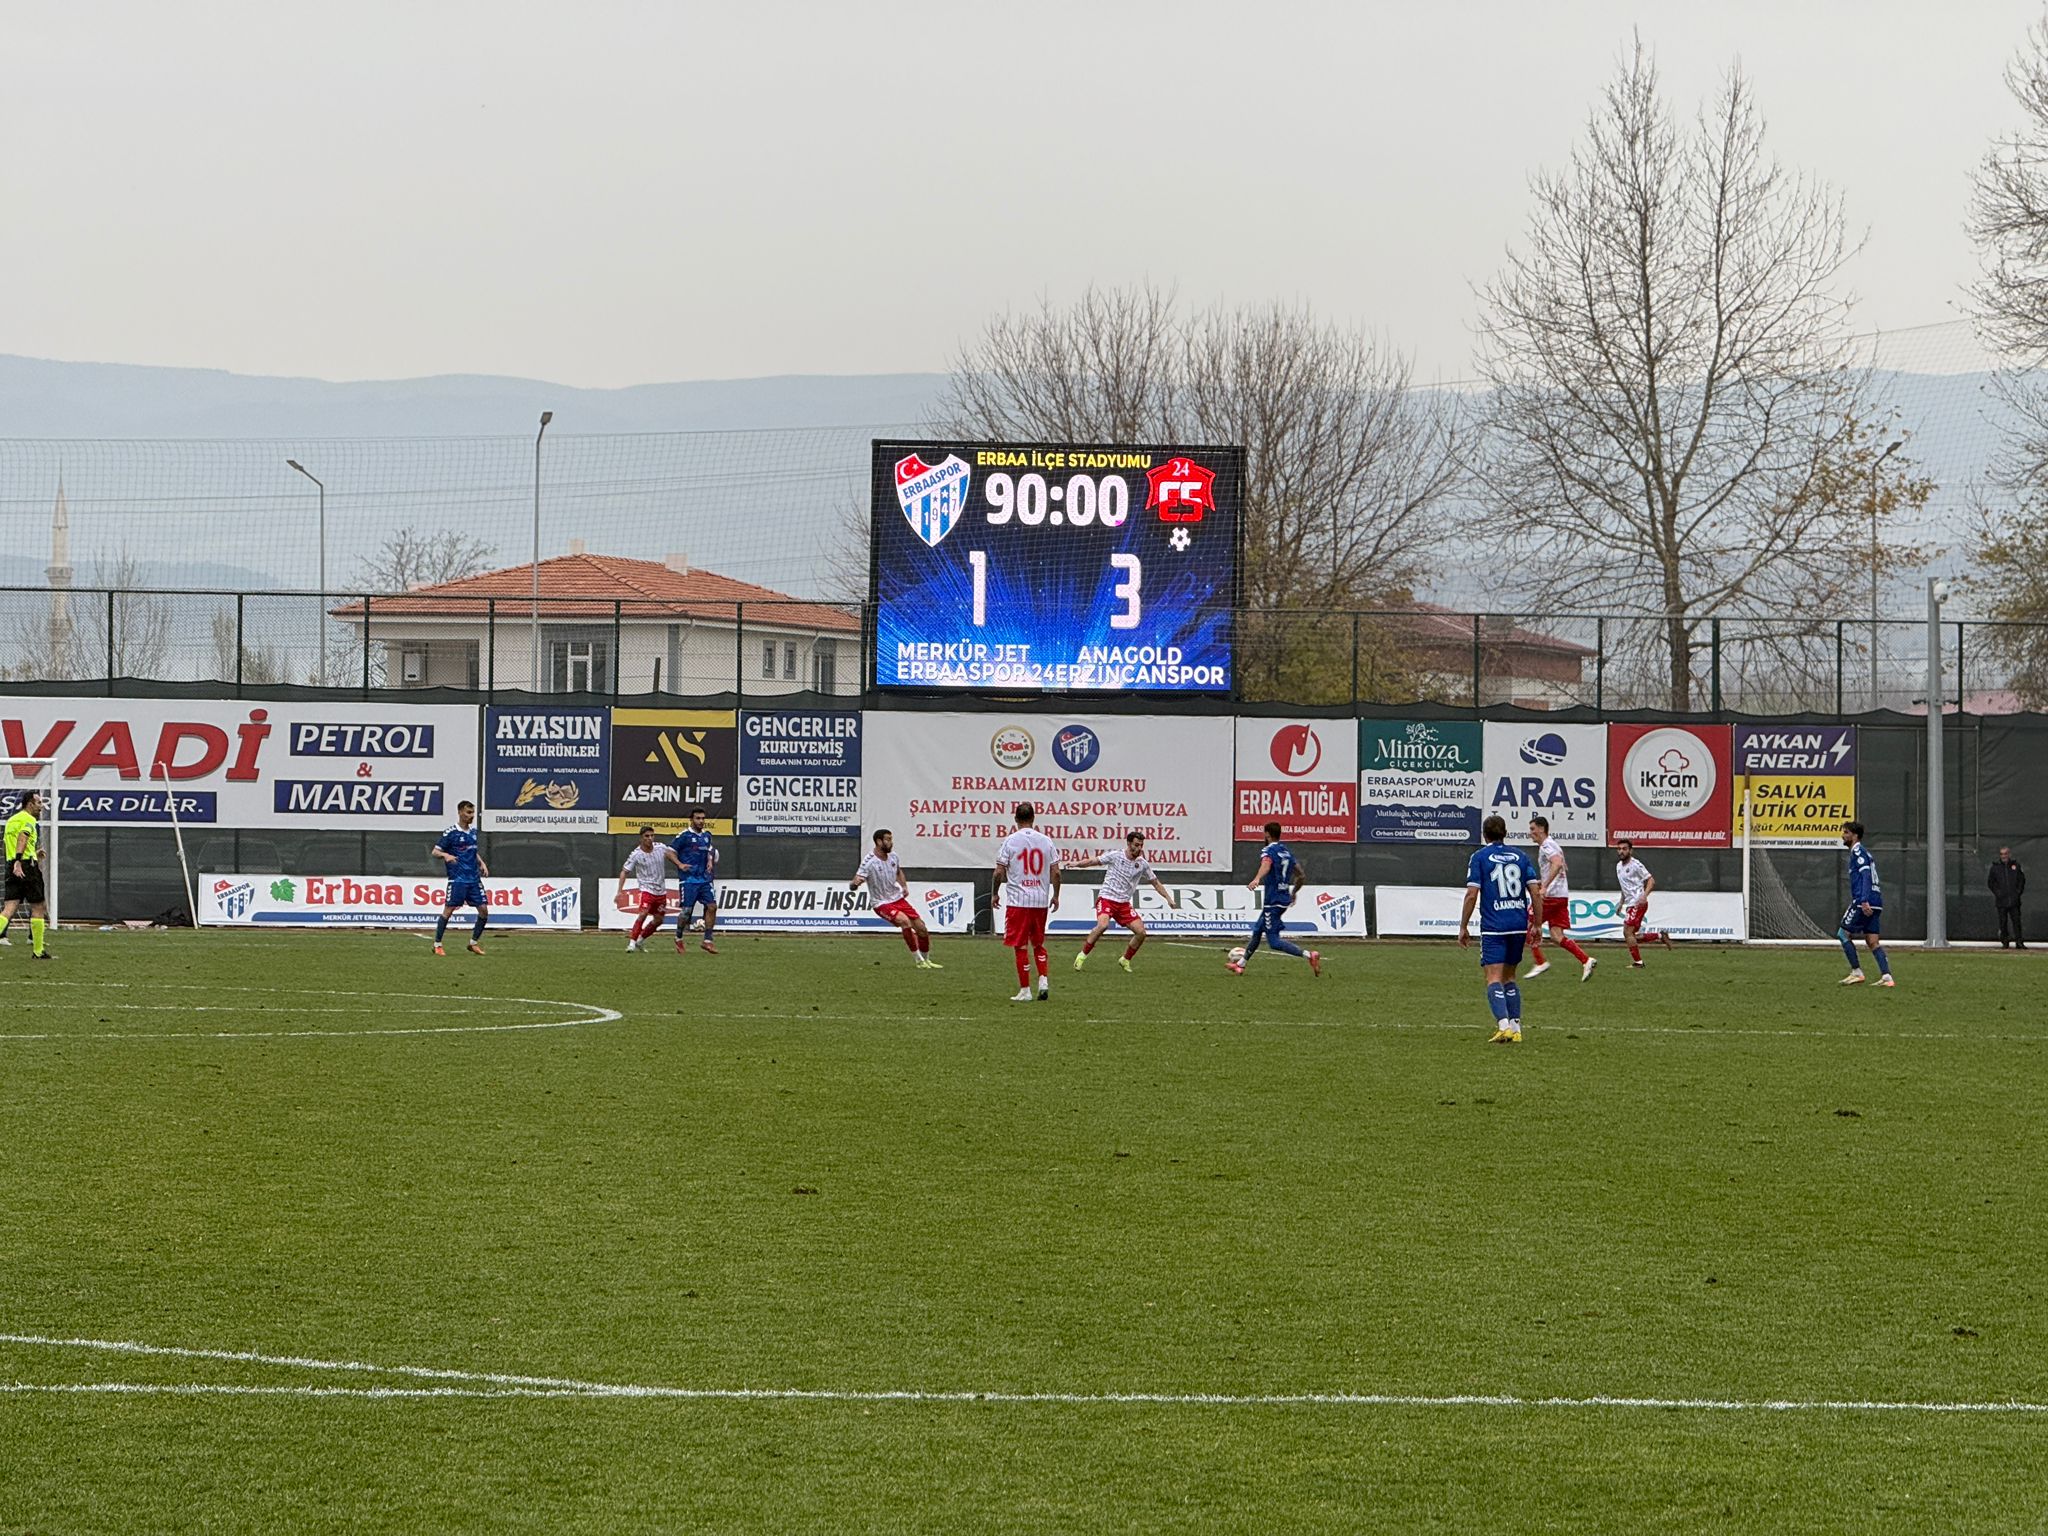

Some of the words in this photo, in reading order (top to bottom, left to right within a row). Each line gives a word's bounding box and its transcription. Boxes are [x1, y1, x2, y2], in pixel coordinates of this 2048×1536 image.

[977, 452, 1027, 466] ERBAA
[1032, 450, 1065, 470] İLÇE
[1071, 454, 1151, 469] STADYUMU
[1173, 460, 1190, 477] 24
[902, 462, 961, 500] ERBAASPOR
[985, 472, 1129, 527] 90:00
[969, 551, 987, 627] 1
[1110, 553, 1142, 630] 3
[898, 638, 987, 661] MERKÜR
[993, 644, 1031, 662] JET
[1077, 645, 1183, 665] ANAGOLD
[898, 661, 1027, 681] ERBAASPOR
[1031, 661, 1225, 685] 24ERZİNCANSPOR
[495, 715, 602, 740] AYASUN
[745, 716, 858, 738] GENCERLER
[1, 708, 272, 782] VADİ
[296, 724, 428, 754] PETROL
[760, 738, 844, 758] KURUYEMİŞ
[1742, 733, 1822, 749] AYKAN
[497, 744, 537, 757] TARIM
[539, 742, 600, 758] ÜRÜNLERİ
[1374, 738, 1469, 765] Mimoza
[1745, 750, 1827, 769] ENERJİ
[356, 762, 372, 778] &
[1389, 761, 1455, 769] ÇİÇEKÇİLİK
[746, 776, 858, 798] GENCERLER
[952, 776, 1066, 792] ERBAAMIZIN
[1072, 778, 1146, 793] GURURU
[1367, 776, 1476, 787] ERBAASPOR'UMUZA
[1641, 771, 1698, 788] ikram
[288, 783, 440, 813] MARKET
[622, 784, 681, 803] ASRIN
[685, 781, 723, 804] LİFE
[1369, 788, 1430, 799] BAŞARILAR
[1432, 788, 1474, 799] DİLERİZ
[1491, 776, 1596, 808] ARAS
[1651, 789, 1688, 799] yemek
[1756, 781, 1827, 799] SALVİA
[120, 794, 204, 814] DİLER.
[750, 799, 788, 812] DÜĞÜN
[791, 802, 857, 813] SALONLARI
[909, 796, 1005, 817] ŞAMPİYON
[1010, 801, 1188, 817] EBAASPOR'UMUZA
[1240, 789, 1294, 816] ERBAA
[1299, 784, 1350, 817] TUĞLA
[547, 815, 577, 826] BAŞARILAR
[773, 815, 803, 823] BİRLİKTE
[804, 815, 820, 823] YENİ
[1803, 804, 1852, 819] OTEL
[915, 820, 991, 838] 2.LİG'TE
[1294, 826, 1324, 835] BAŞARILAR
[1017, 847, 1044, 877] 10
[1021, 878, 1041, 887] KERİM
[1490, 863, 1522, 898] 18
[216, 882, 251, 900] ERBAASPOR
[306, 878, 403, 906] Erbaa
[540, 886, 574, 904] ERBAASPOR
[927, 891, 961, 908] ERBAASPOR
[1319, 893, 1353, 911] ERBAASPOR
[322, 913, 351, 921] MERKÜR
[805, 919, 839, 927] BAŞARILAR
[839, 918, 859, 926] DİLER.
[1196, 922, 1231, 931] BAŞARILAR
[1231, 922, 1251, 930] DİLER.
